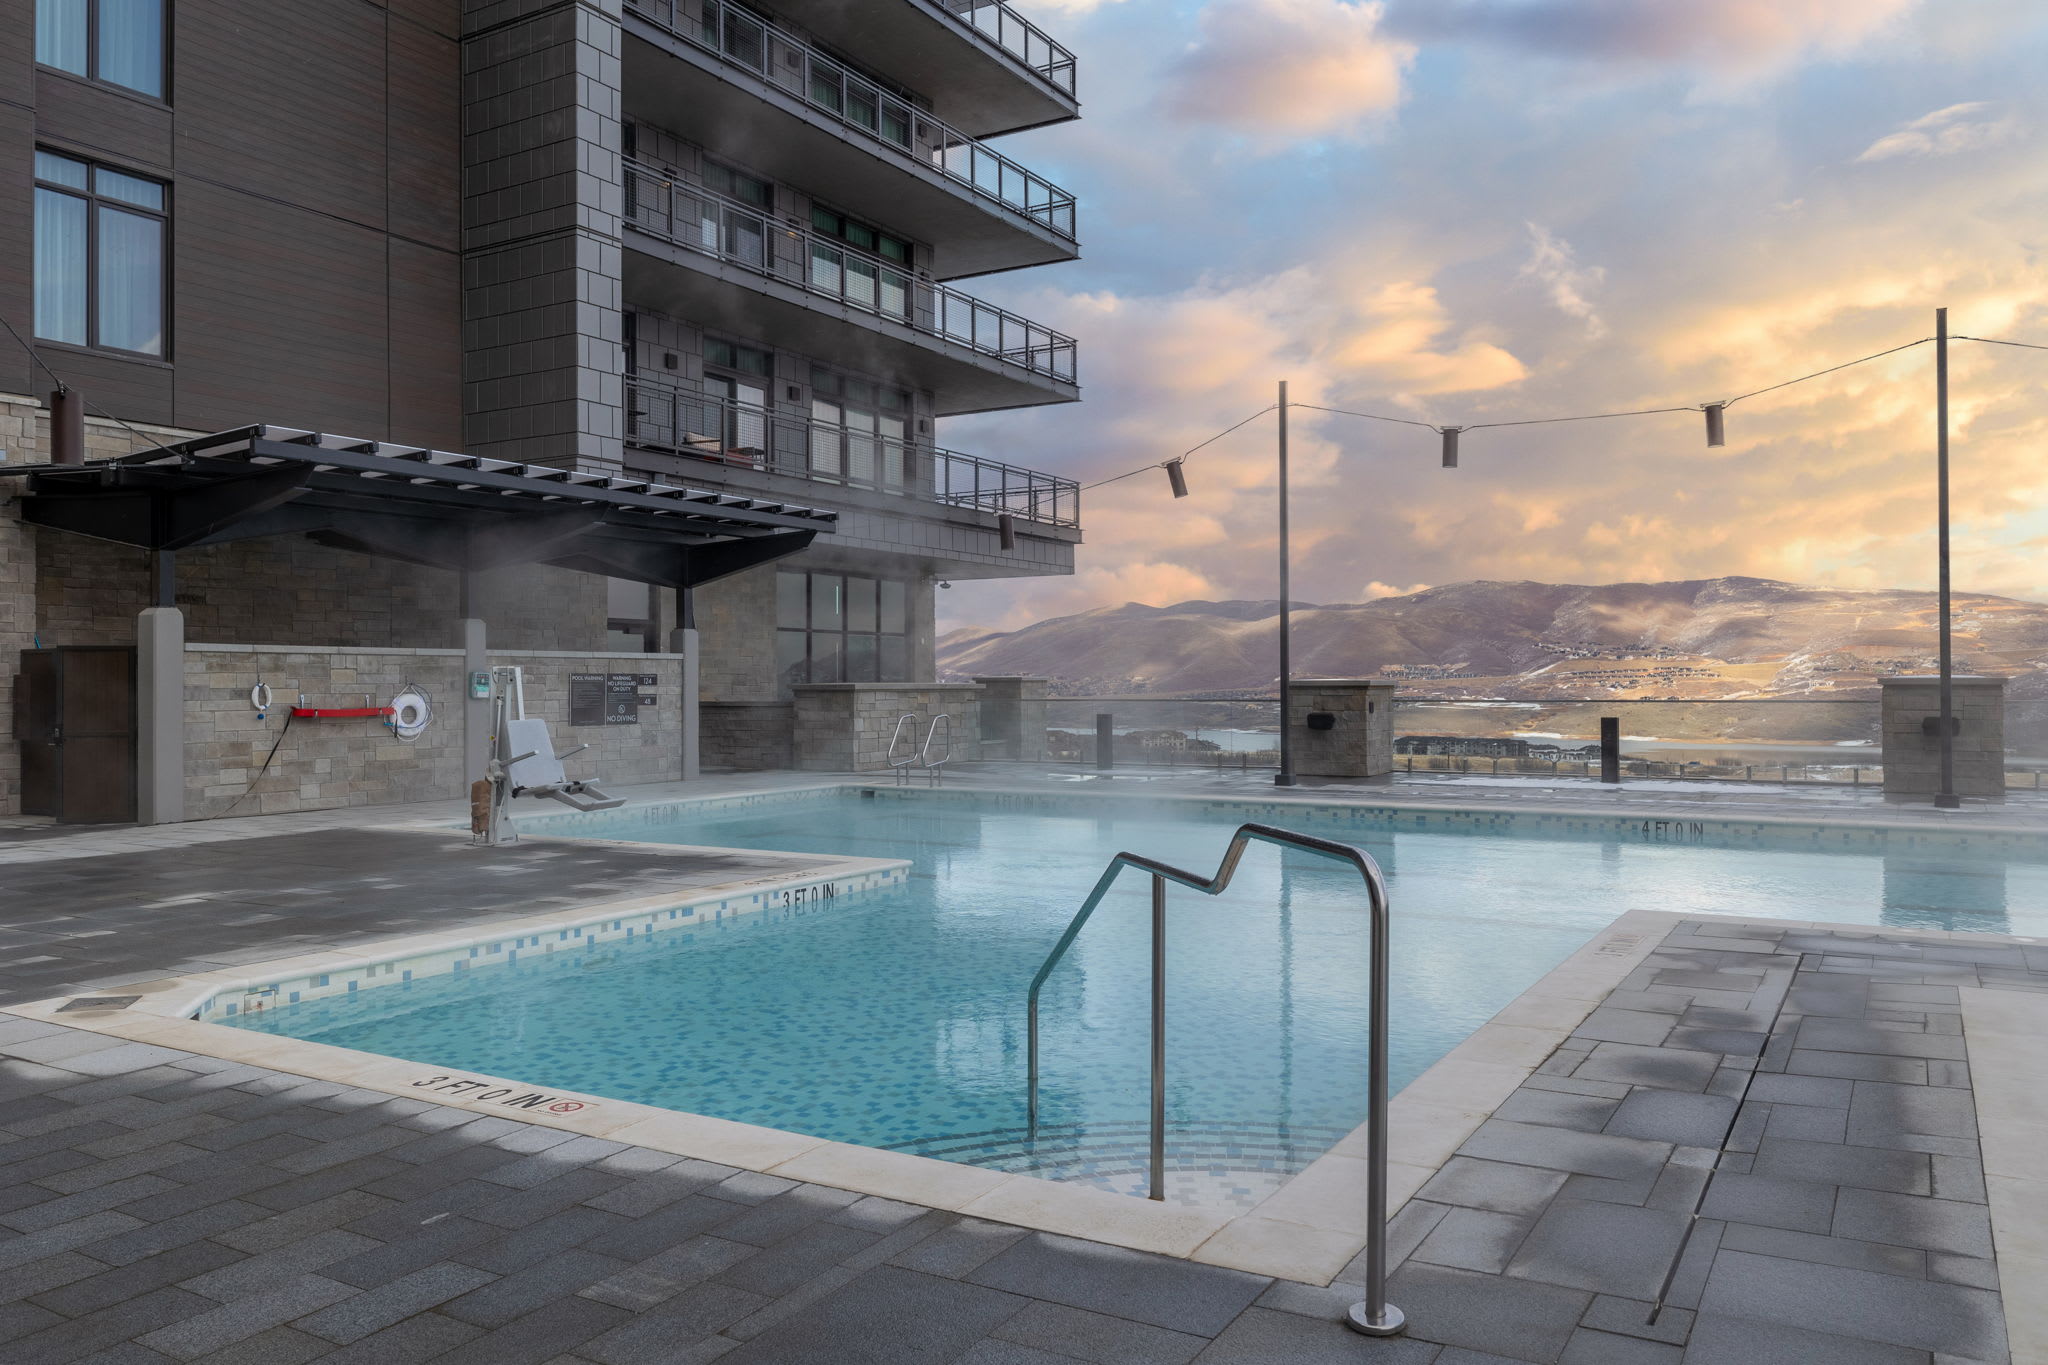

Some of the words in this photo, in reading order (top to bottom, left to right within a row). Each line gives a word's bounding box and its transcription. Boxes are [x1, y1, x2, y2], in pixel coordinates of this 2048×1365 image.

[1642, 820, 1649, 832] 4
[1656, 822, 1670, 833] FT
[1690, 822, 1704, 834] IN
[784, 892, 790, 907] 3
[794, 888, 806, 904] FT
[823, 883, 834, 899] IN
[412, 1075, 449, 1087] 3
[434, 1080, 490, 1095] FT
[503, 1093, 555, 1109] IN
